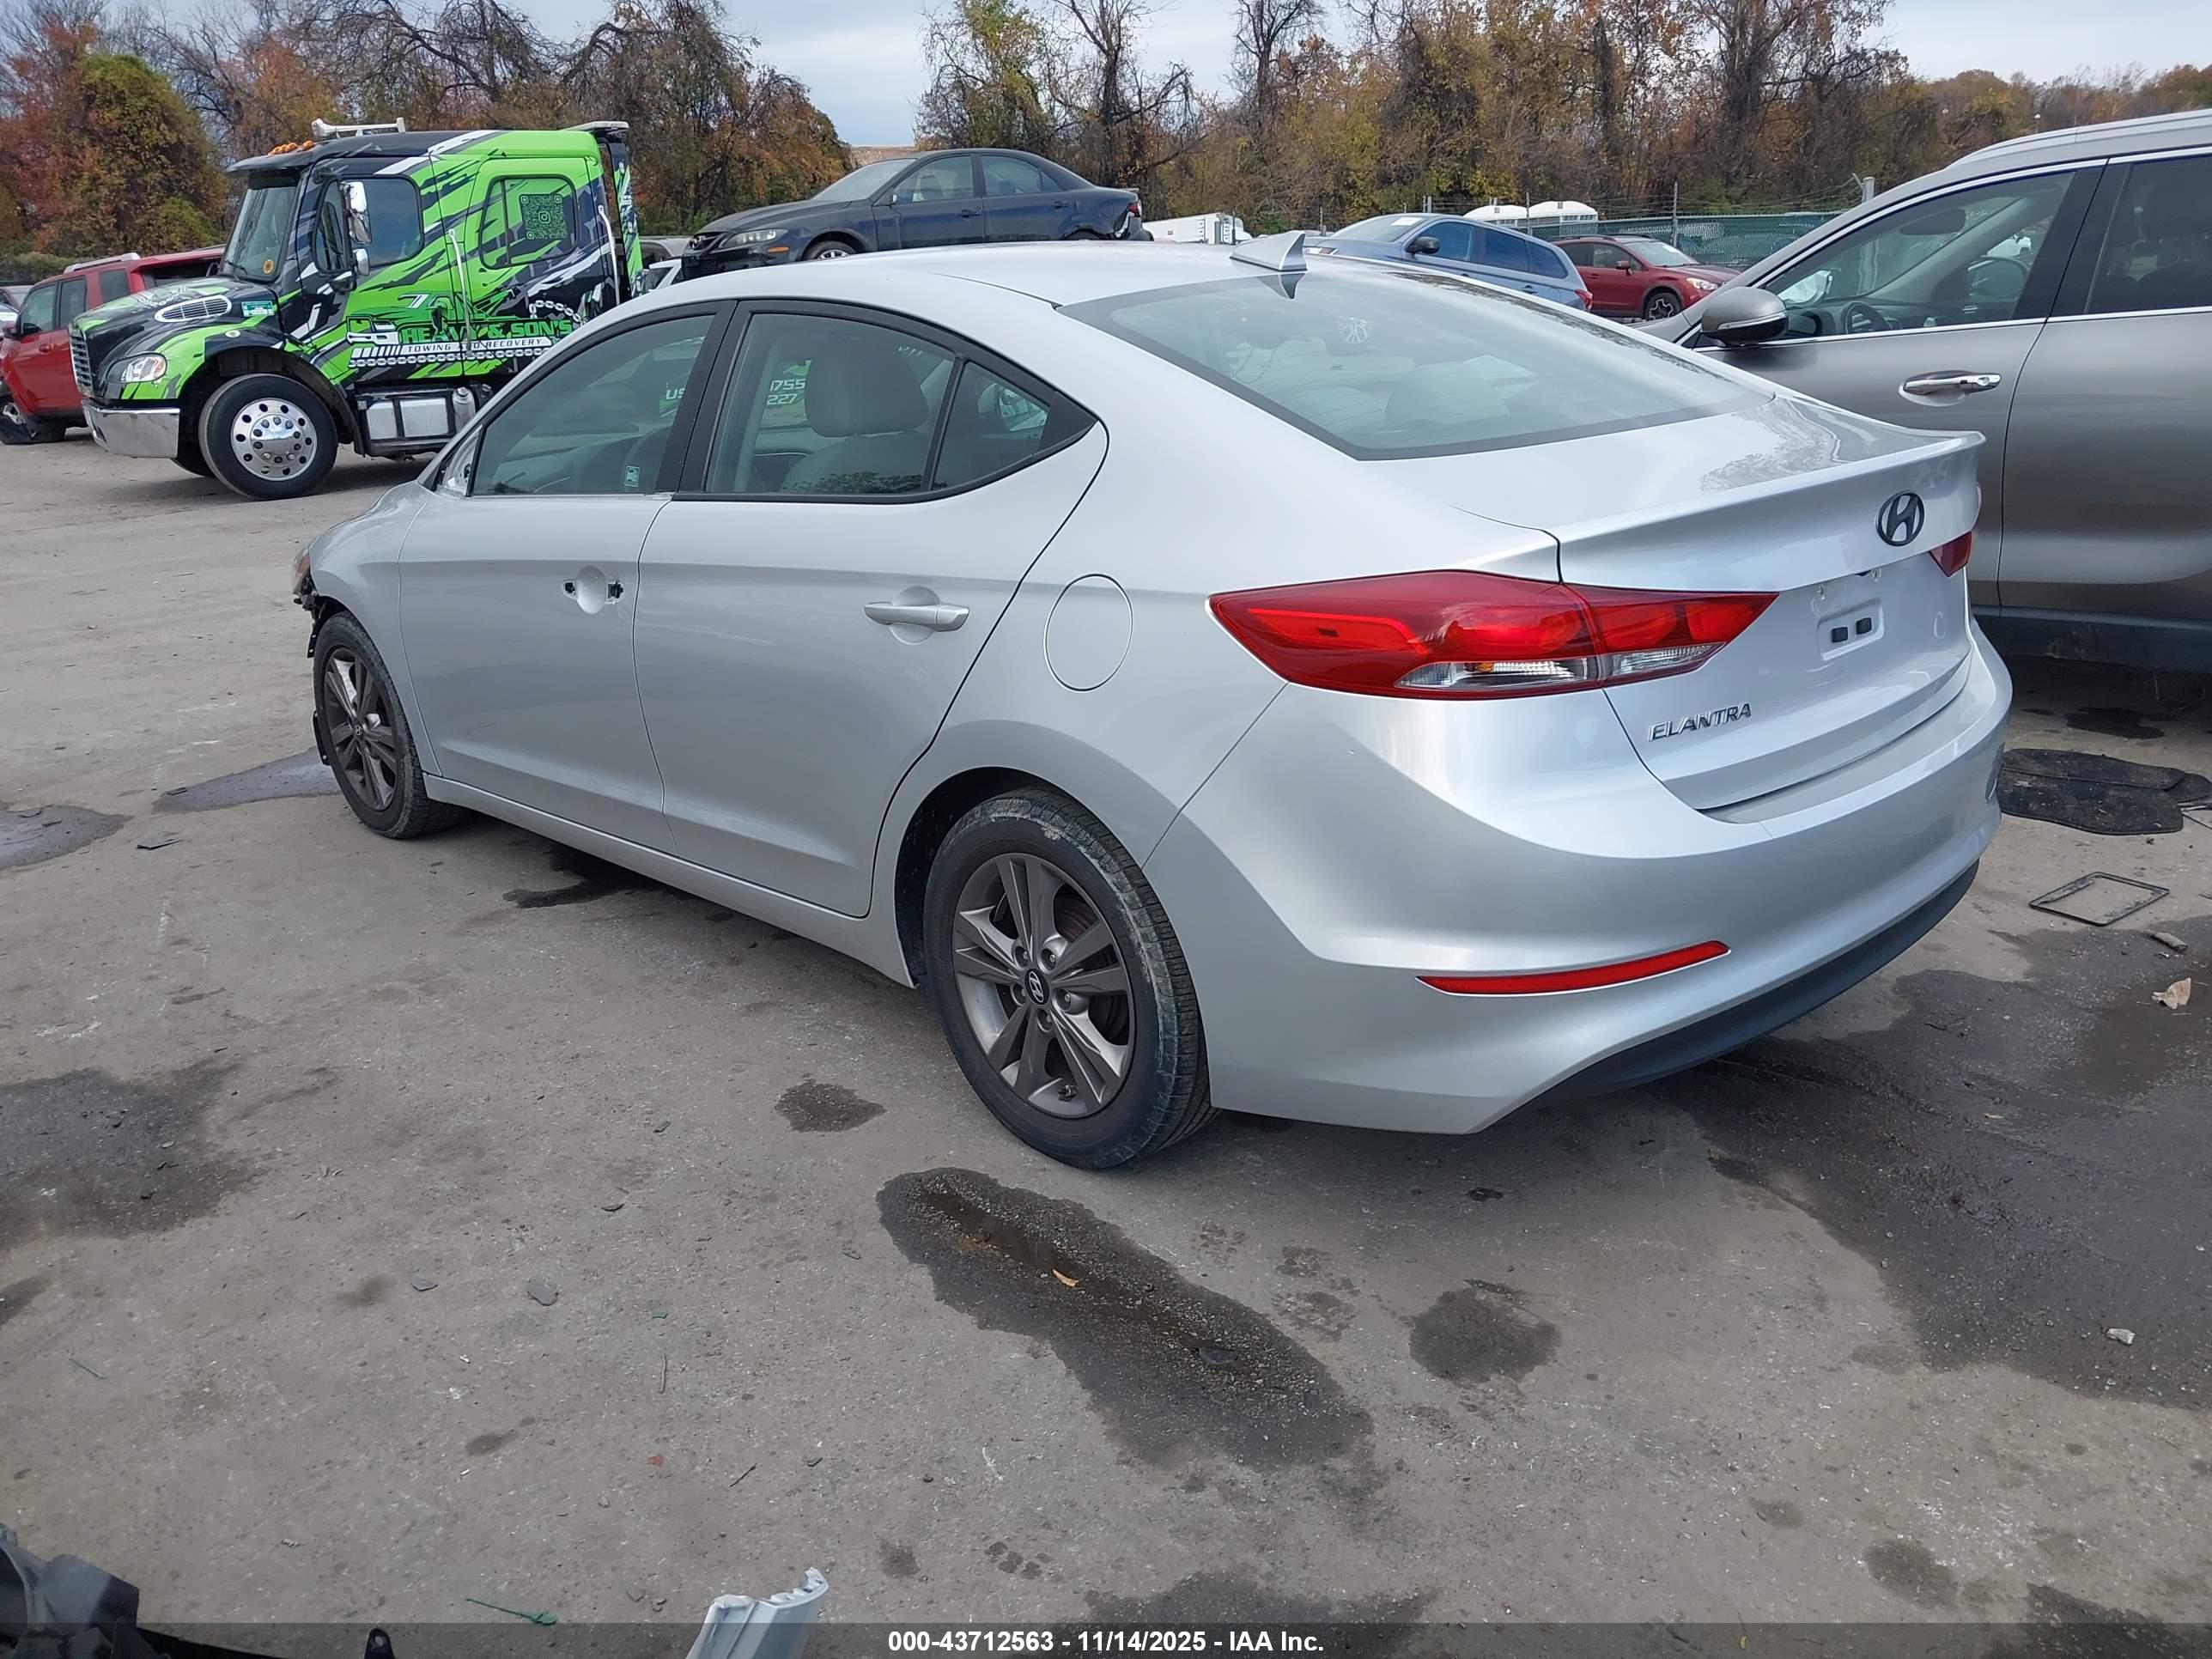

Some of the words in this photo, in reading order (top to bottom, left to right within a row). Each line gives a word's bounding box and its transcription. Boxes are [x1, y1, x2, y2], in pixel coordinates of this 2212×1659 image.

[488, 323, 505, 339] &
[511, 319, 573, 337] SON'S
[408, 343, 451, 353] TOWING
[485, 337, 543, 349] RECOVERY
[1648, 702, 1752, 741] ELANTRA
